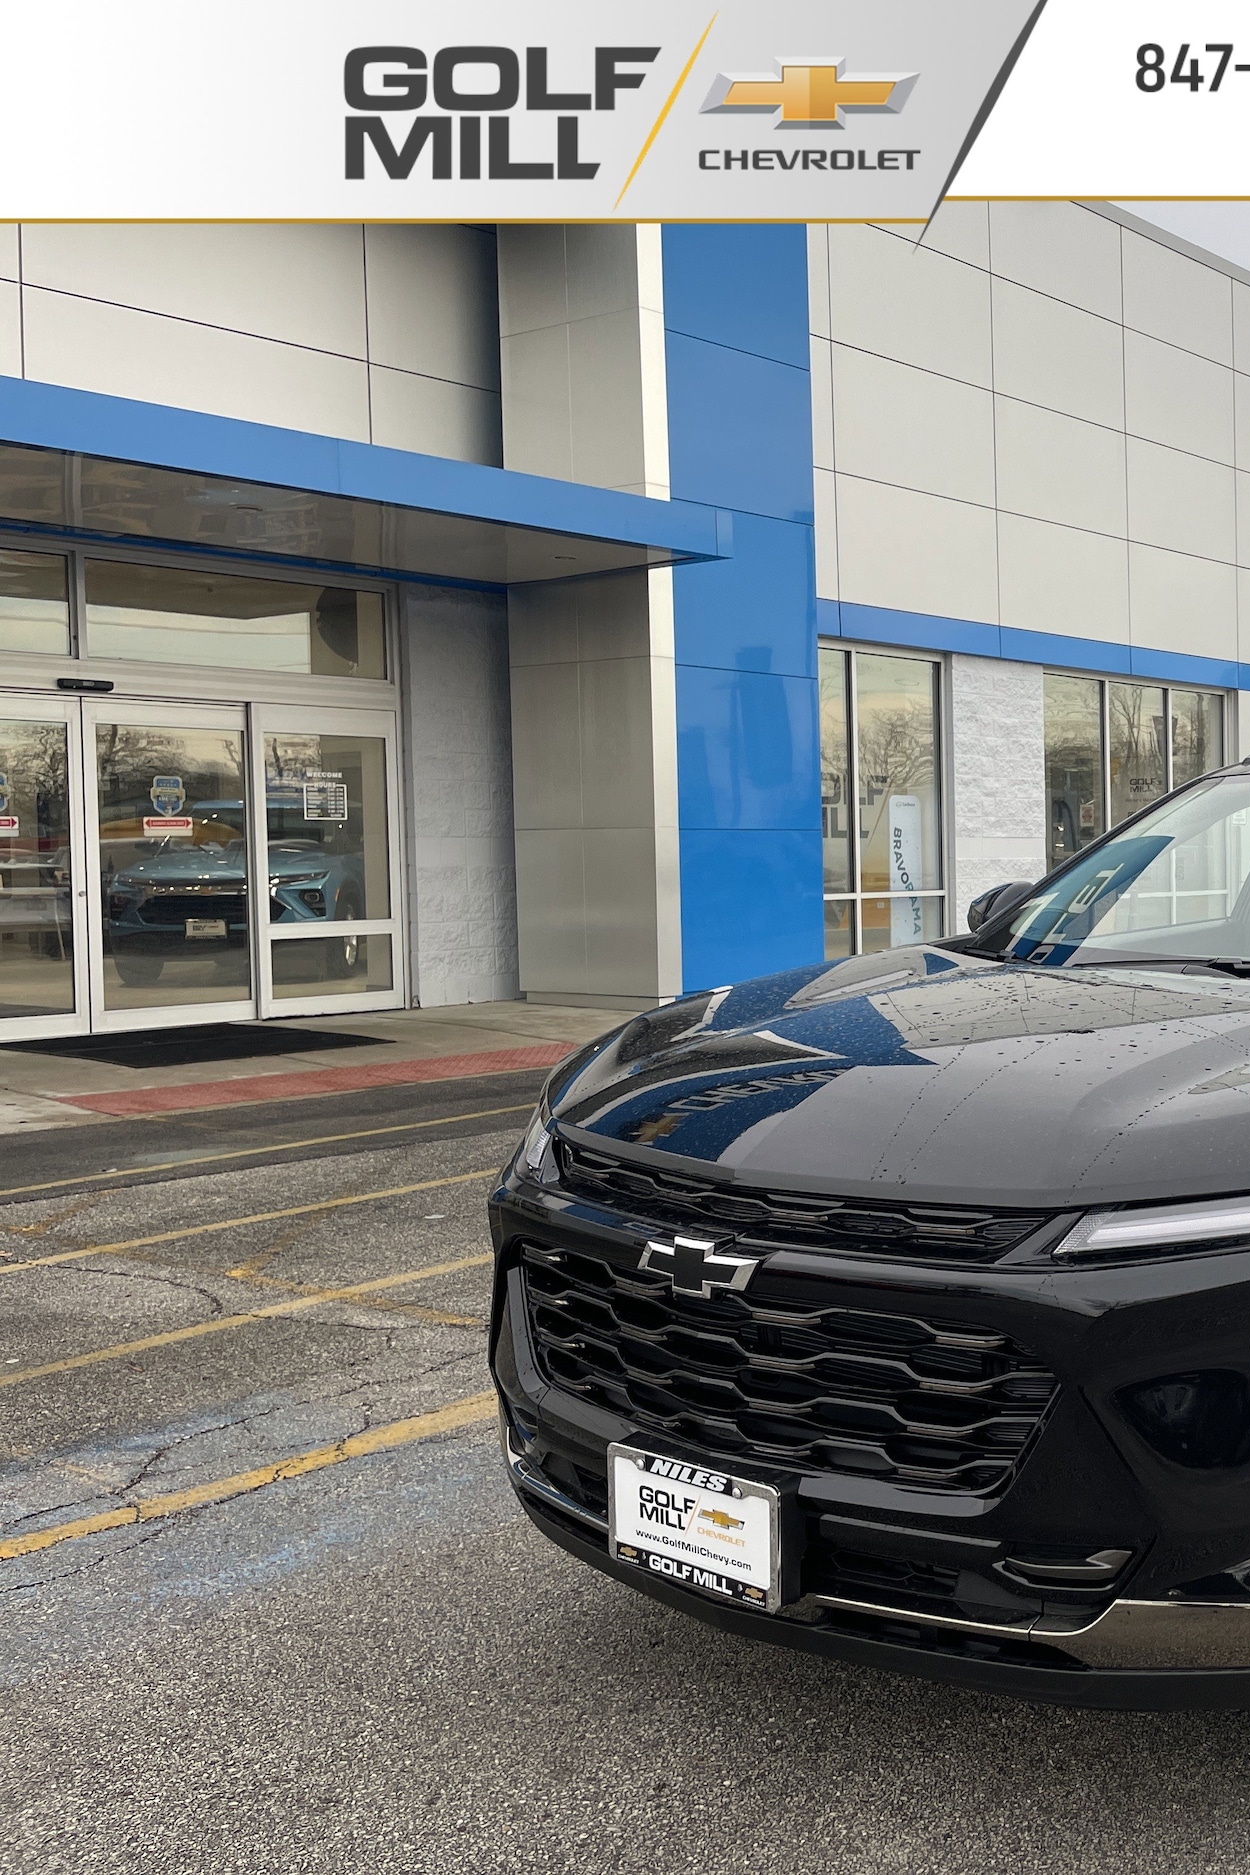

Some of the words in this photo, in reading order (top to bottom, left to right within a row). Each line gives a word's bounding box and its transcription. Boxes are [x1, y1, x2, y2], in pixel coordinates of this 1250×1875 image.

[821, 772, 889, 805] OLF
[893, 827, 922, 935] BRAVORAMA
[650, 1458, 728, 1493] NILES
[639, 1485, 696, 1515] GOLF
[639, 1502, 686, 1531] MILL
[635, 1528, 752, 1572] www.GolfMillChevy.com
[697, 1526, 746, 1548] CHEVROLET
[648, 1554, 693, 1581] GOLF
[693, 1569, 733, 1596] MILL
